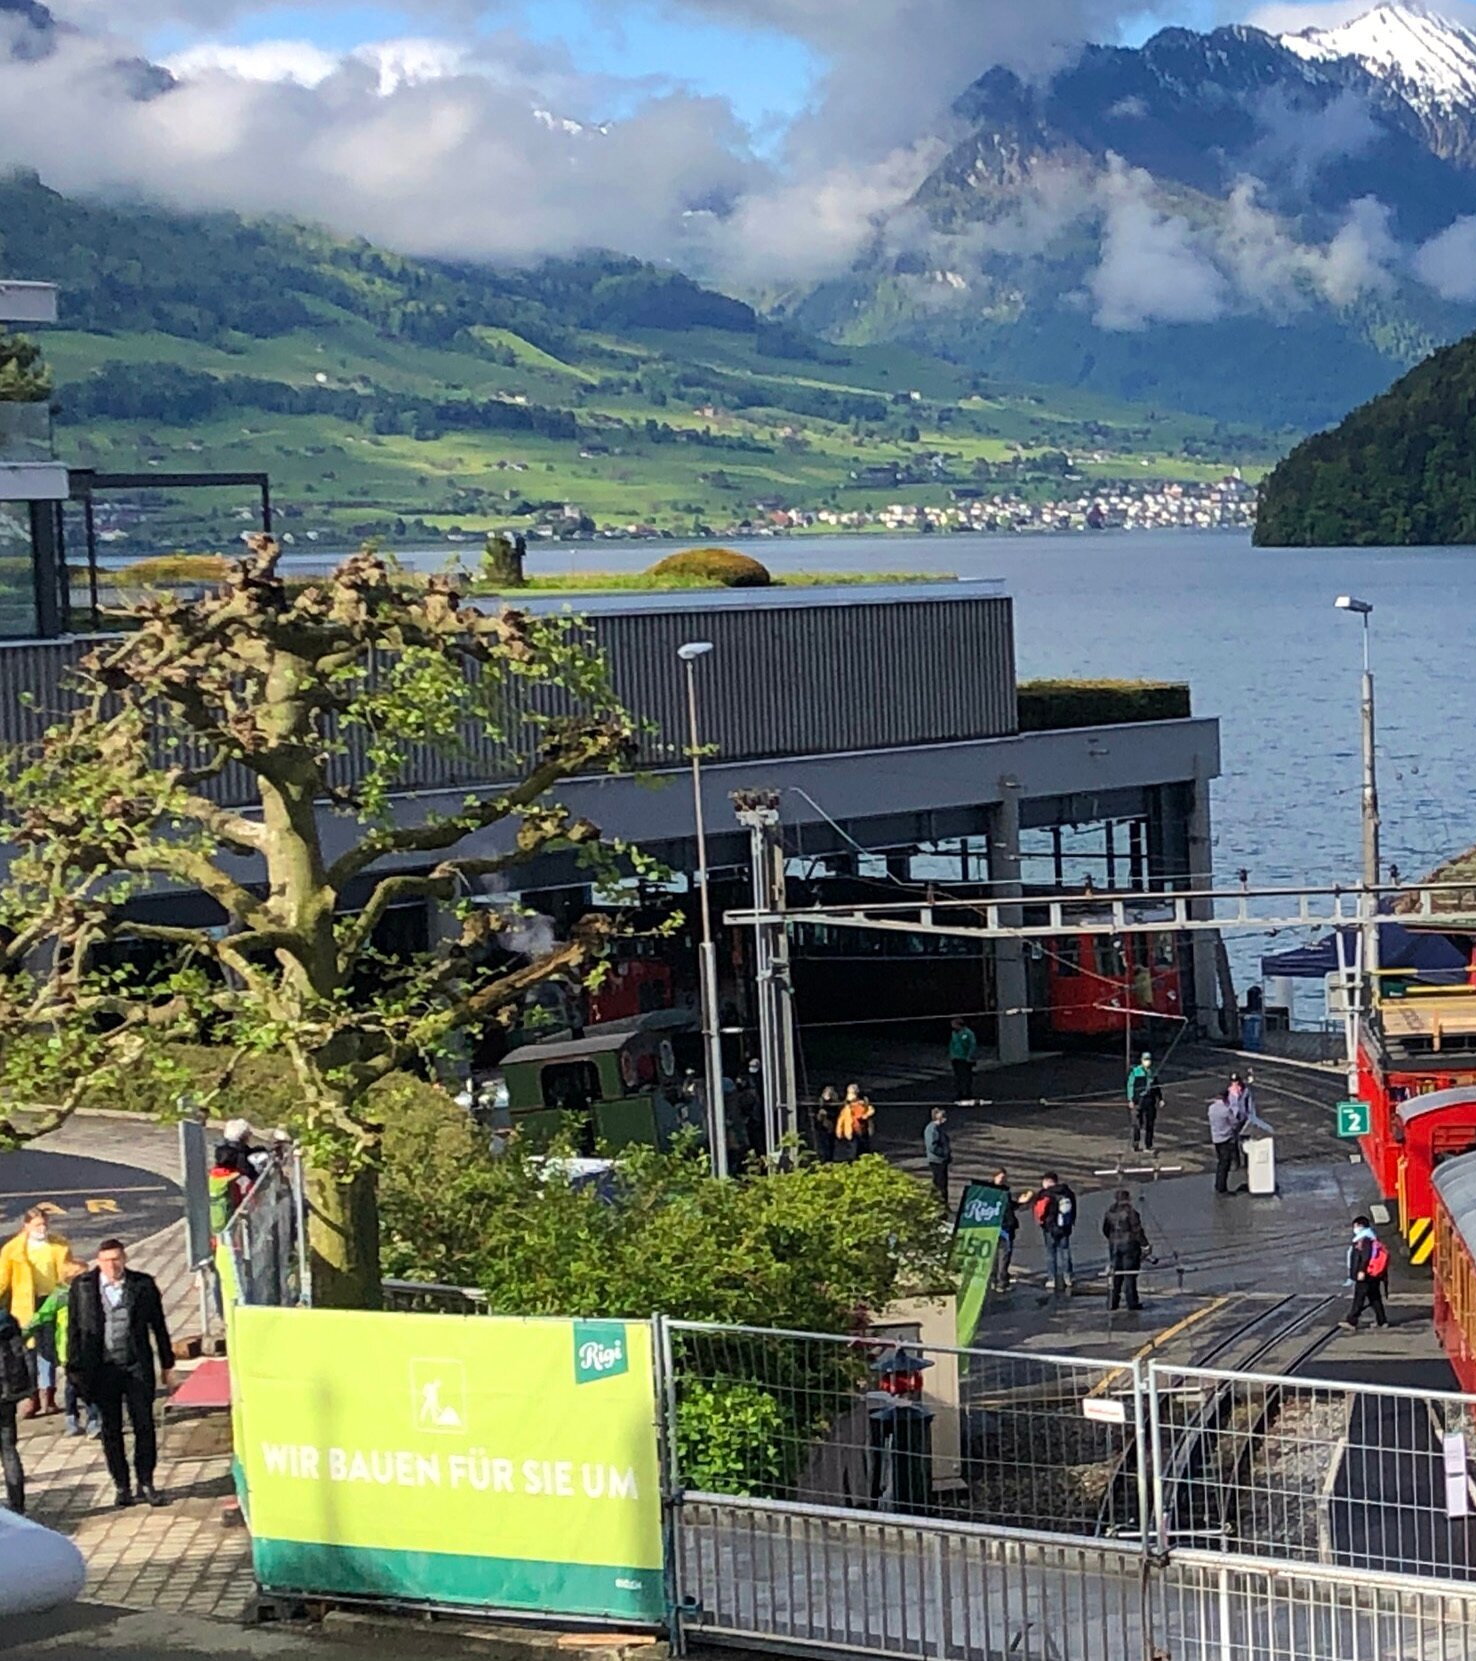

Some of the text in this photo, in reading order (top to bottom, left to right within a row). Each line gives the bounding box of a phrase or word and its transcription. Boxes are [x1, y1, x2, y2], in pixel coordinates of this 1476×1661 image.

[1348, 1113, 1361, 1132] 2
[964, 1199, 1002, 1222] Rigi
[579, 1340, 623, 1371] Rigi
[260, 1441, 639, 1500] WIR BAUEN FÜR SIE UM
